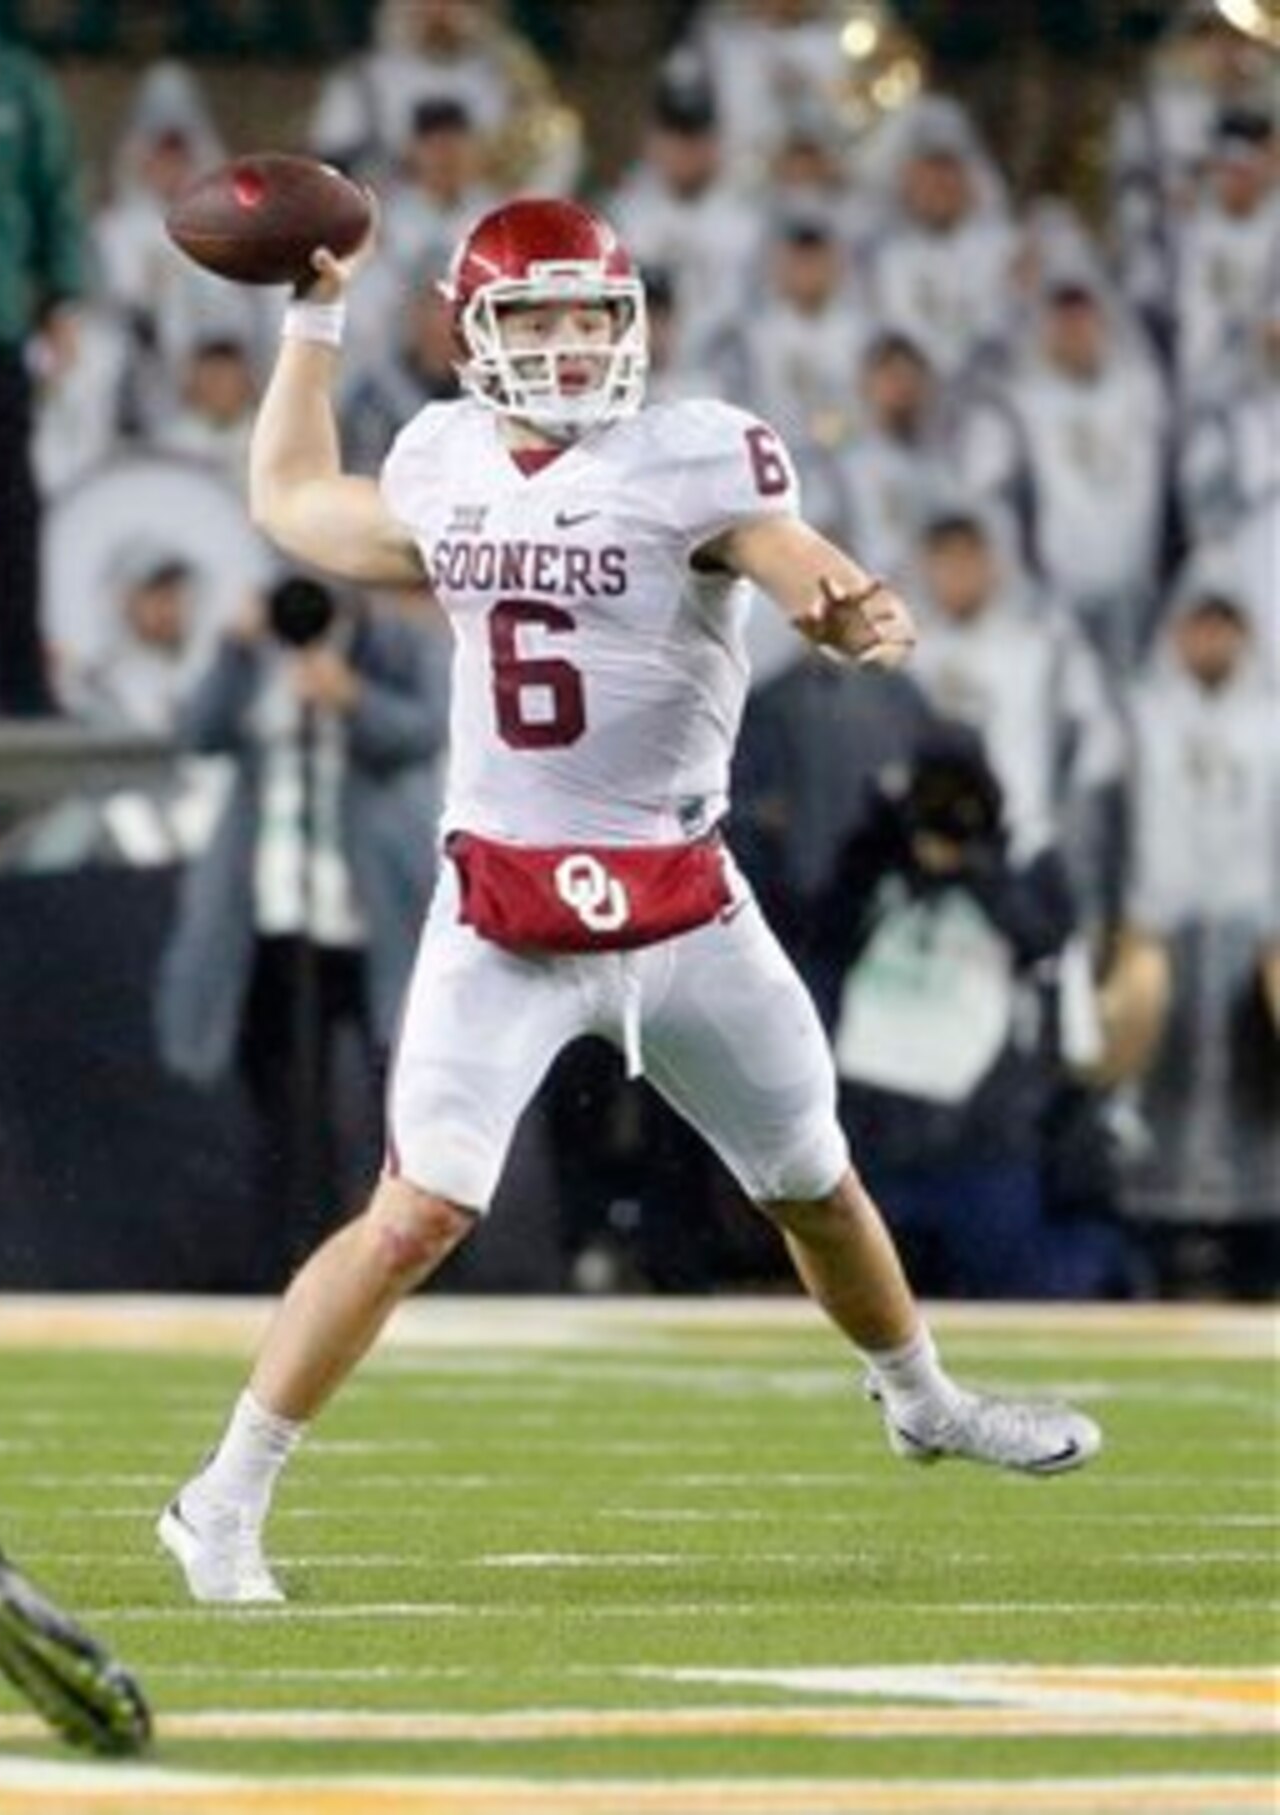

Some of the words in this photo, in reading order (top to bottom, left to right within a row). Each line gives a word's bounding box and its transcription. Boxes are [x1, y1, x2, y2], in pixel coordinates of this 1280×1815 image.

[744, 426, 790, 496] 6
[432, 539, 628, 597] SOONERS
[488, 599, 588, 752] 6
[554, 854, 628, 931] OU
